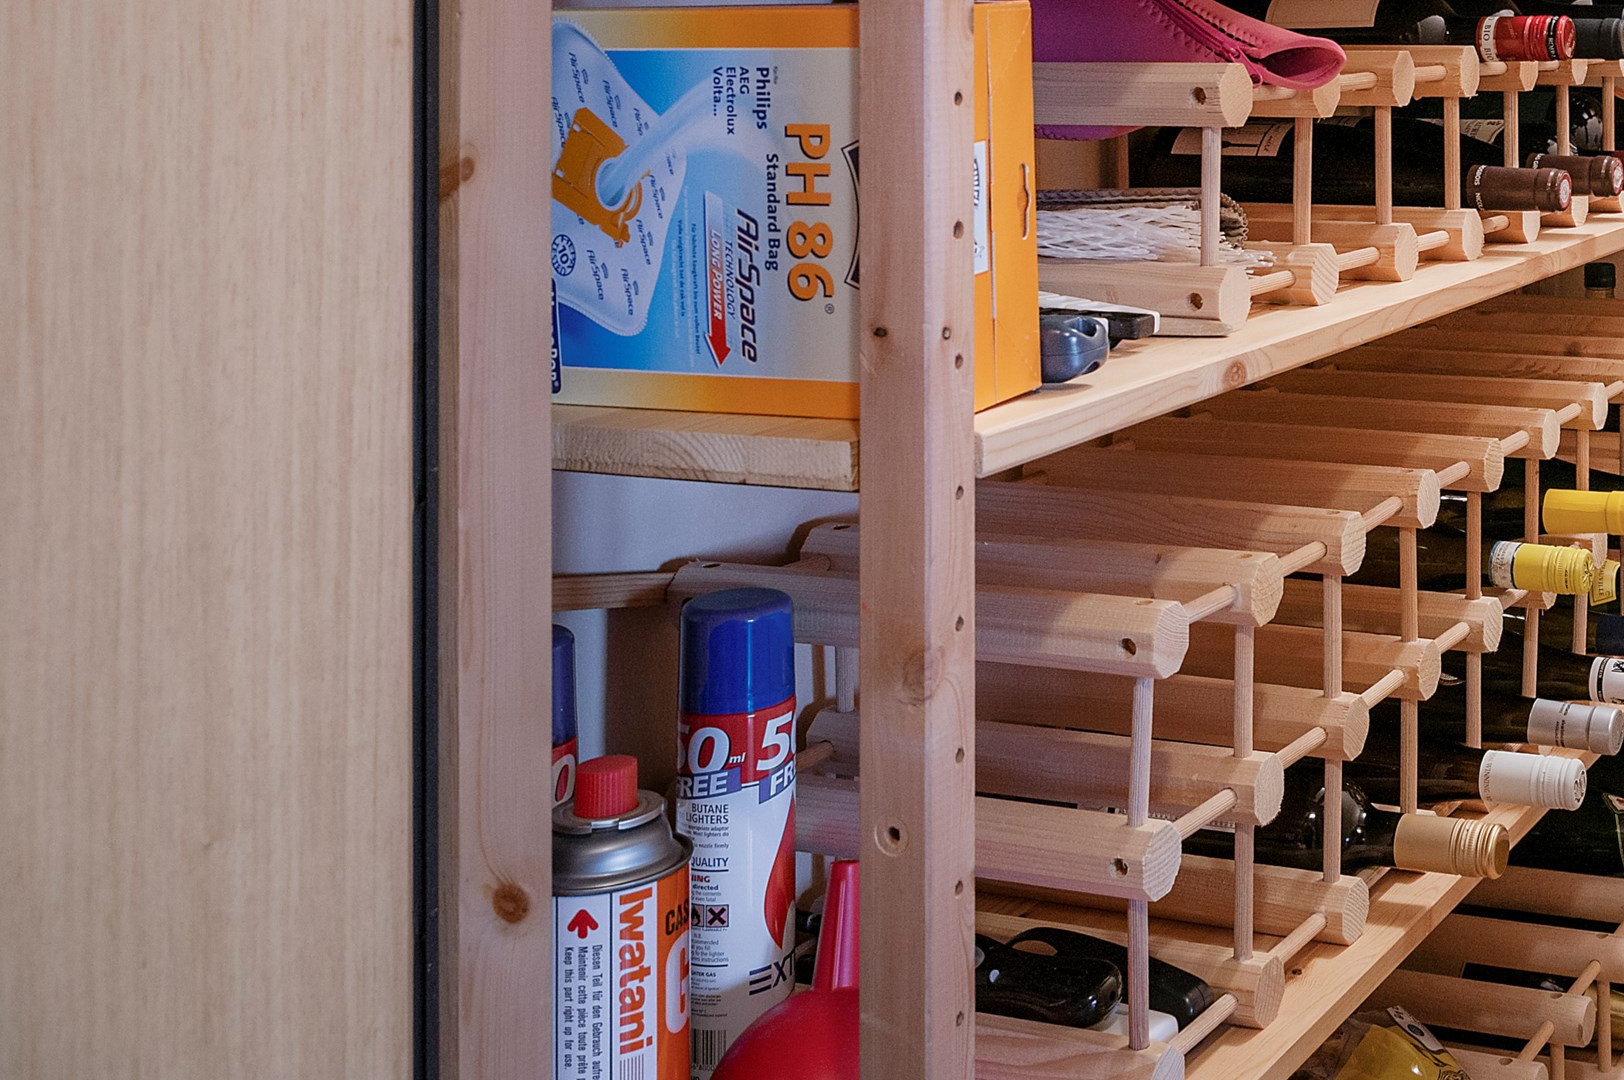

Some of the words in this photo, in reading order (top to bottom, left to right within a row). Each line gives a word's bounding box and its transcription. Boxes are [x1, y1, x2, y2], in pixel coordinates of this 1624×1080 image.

[568, 52, 584, 103] AirSpace
[739, 66, 749, 95] AEG
[602, 80, 618, 128] AirSpace
[713, 66, 723, 117] Volta...
[726, 66, 737, 135] Electrolux
[753, 66, 770, 130] Philips
[784, 123, 832, 207] PH
[648, 174, 663, 220] AirSpace
[766, 153, 781, 233] Standard
[557, 244, 569, 265] 10
[636, 219, 652, 265] AirSpace
[711, 229, 720, 266] LONG
[764, 236, 781, 272] Bag
[787, 220, 835, 301] 86
[586, 249, 604, 301] AirSpace
[724, 240, 735, 320] TECHNOLOGY
[736, 208, 760, 363] AirSpace
[621, 268, 634, 316] AirSpace
[712, 268, 723, 320] POWER
[729, 752, 746, 764] ml
[686, 812, 729, 825] LIGHTERS
[691, 803, 729, 814] BUTANE
[691, 857, 729, 868] QUALITY
[563, 946, 574, 966] Keep
[577, 946, 588, 981] Maintenir
[592, 944, 603, 970] Diesen
[708, 950, 725, 958] lighter
[564, 969, 574, 983] this
[592, 973, 603, 987] Teil
[618, 887, 653, 1055] Iwatani
[563, 987, 574, 1002] part
[577, 985, 588, 1004] cette
[592, 990, 603, 1001] für
[563, 1006, 574, 1023] right
[576, 1008, 588, 1027] pièce
[592, 1005, 603, 1019] den
[563, 1026, 574, 1036] up
[577, 1031, 588, 1051] toute
[592, 1022, 603, 1057] Gebrauch
[564, 1039, 574, 1051] for
[564, 1053, 574, 1070] use.
[576, 1055, 588, 1074] prête
